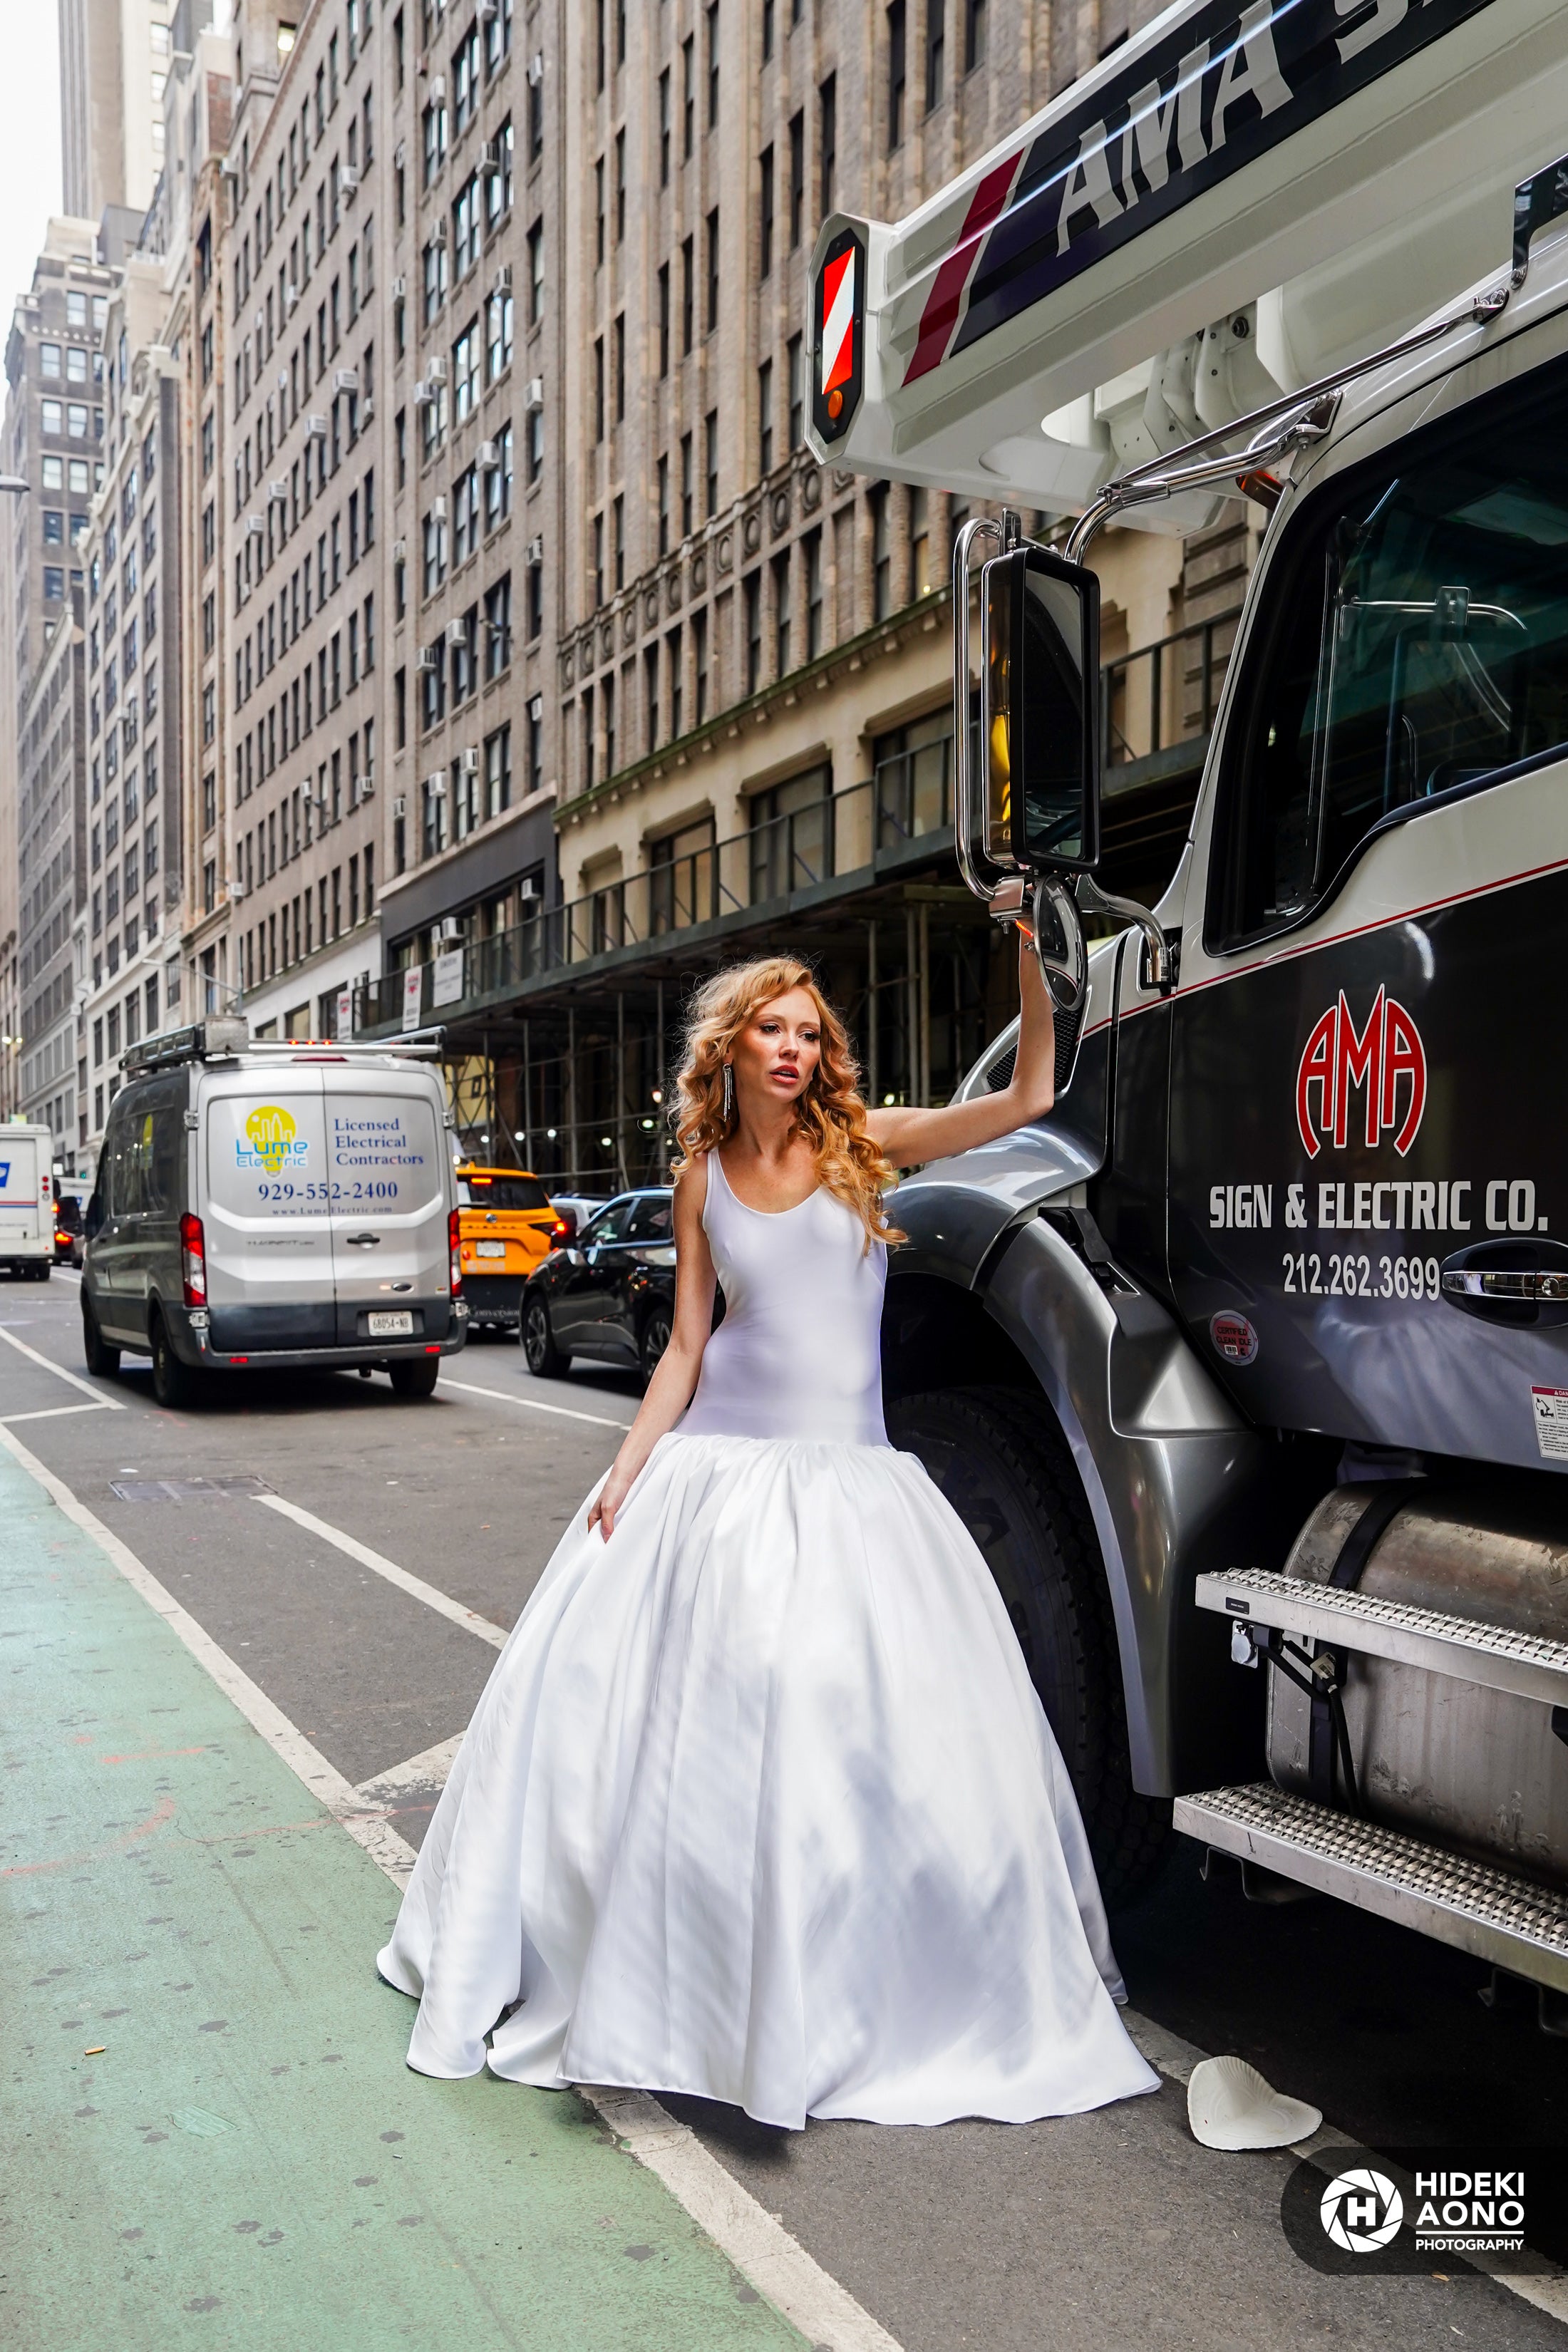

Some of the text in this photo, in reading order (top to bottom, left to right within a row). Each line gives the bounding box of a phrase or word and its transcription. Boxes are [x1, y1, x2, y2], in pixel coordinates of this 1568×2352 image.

[1056, 0, 1294, 257] AMA
[1296, 983, 1427, 1160] AMA
[334, 1118, 400, 1131] Licensed
[236, 1139, 308, 1155] Lume
[335, 1135, 406, 1148] Electrical
[237, 1155, 307, 1167] Electric
[336, 1152, 424, 1166] Contractors
[259, 1182, 398, 1200] 929-552-2400
[1209, 1180, 1548, 1231] SIGN & ELECTRIC CO.
[1282, 1253, 1440, 1301] 212.262.3699
[1217, 1326, 1248, 1336] CERTIFIED
[1216, 1336, 1252, 1346] CLEAN IDLE
